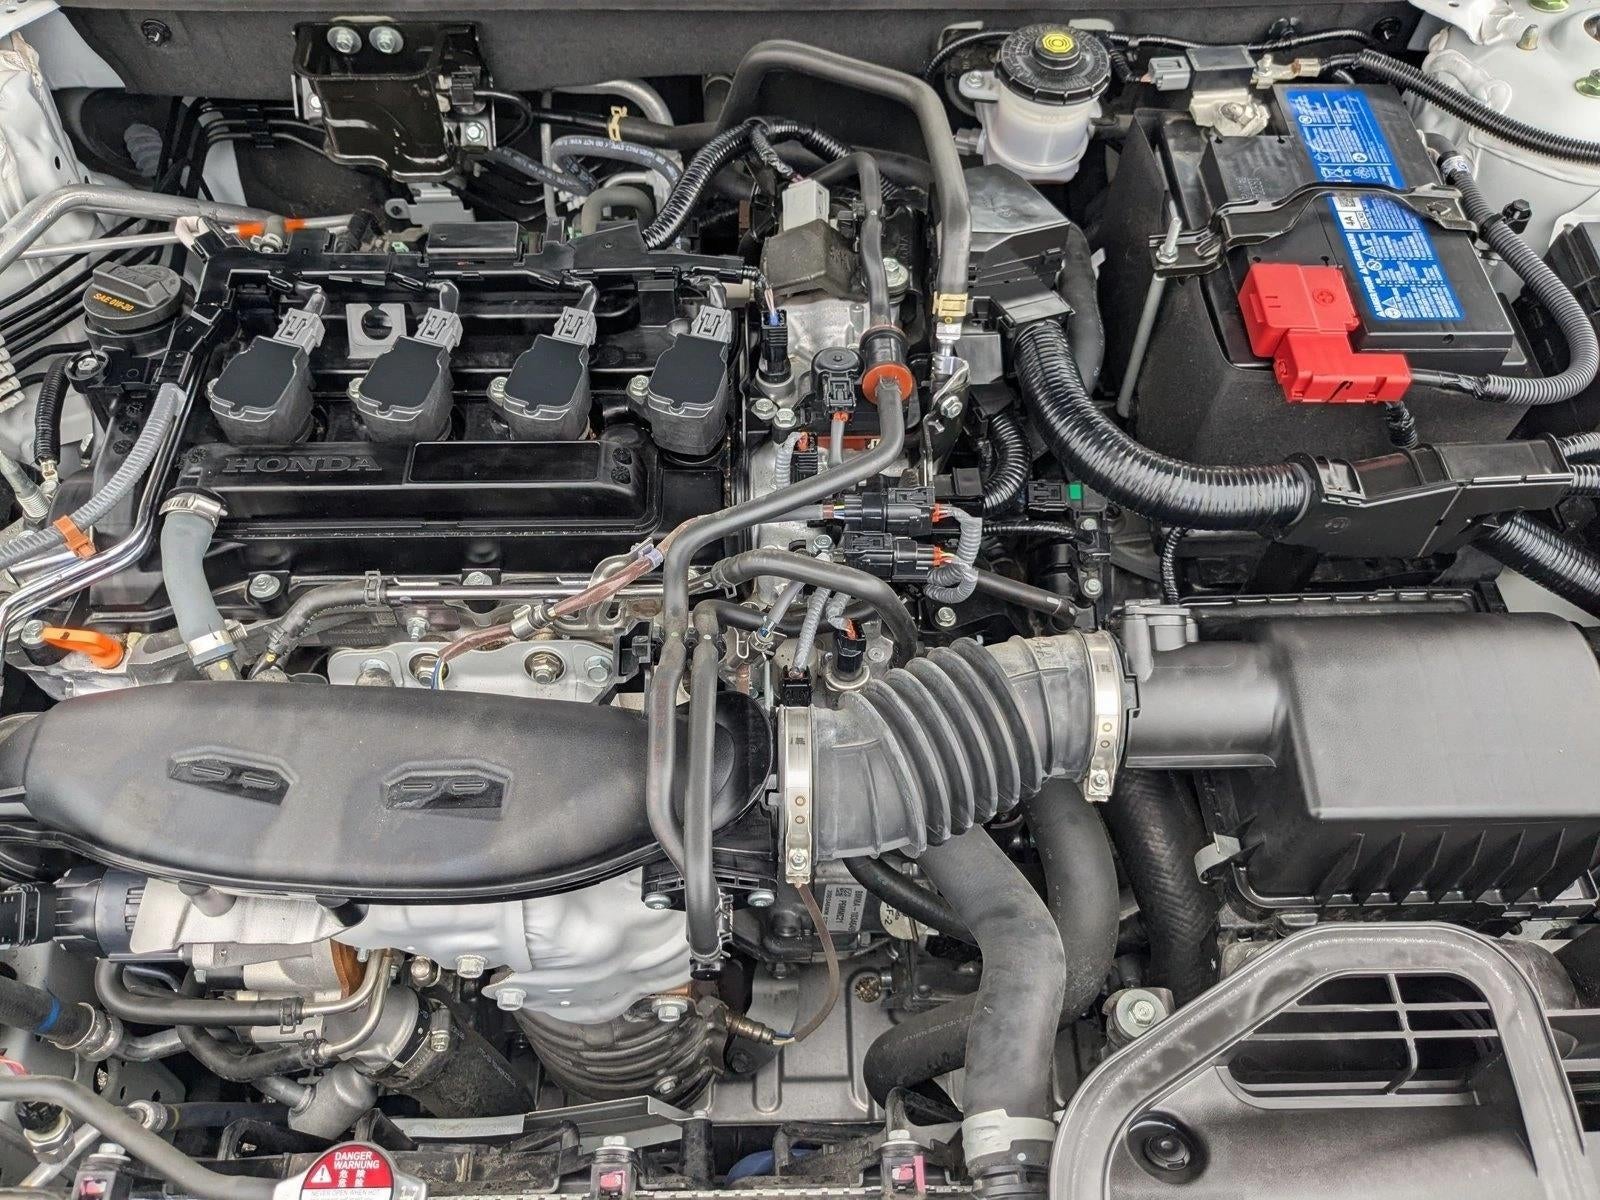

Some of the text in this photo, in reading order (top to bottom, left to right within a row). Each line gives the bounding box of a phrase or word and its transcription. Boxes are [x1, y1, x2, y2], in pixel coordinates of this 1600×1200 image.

[1344, 216, 1355, 226] 4A
[93, 292, 134, 311] SAE 0W-20
[222, 455, 383, 473] HONDA
[335, 1151, 372, 1160] DANGER
[333, 1160, 380, 1169] WARNUNG
